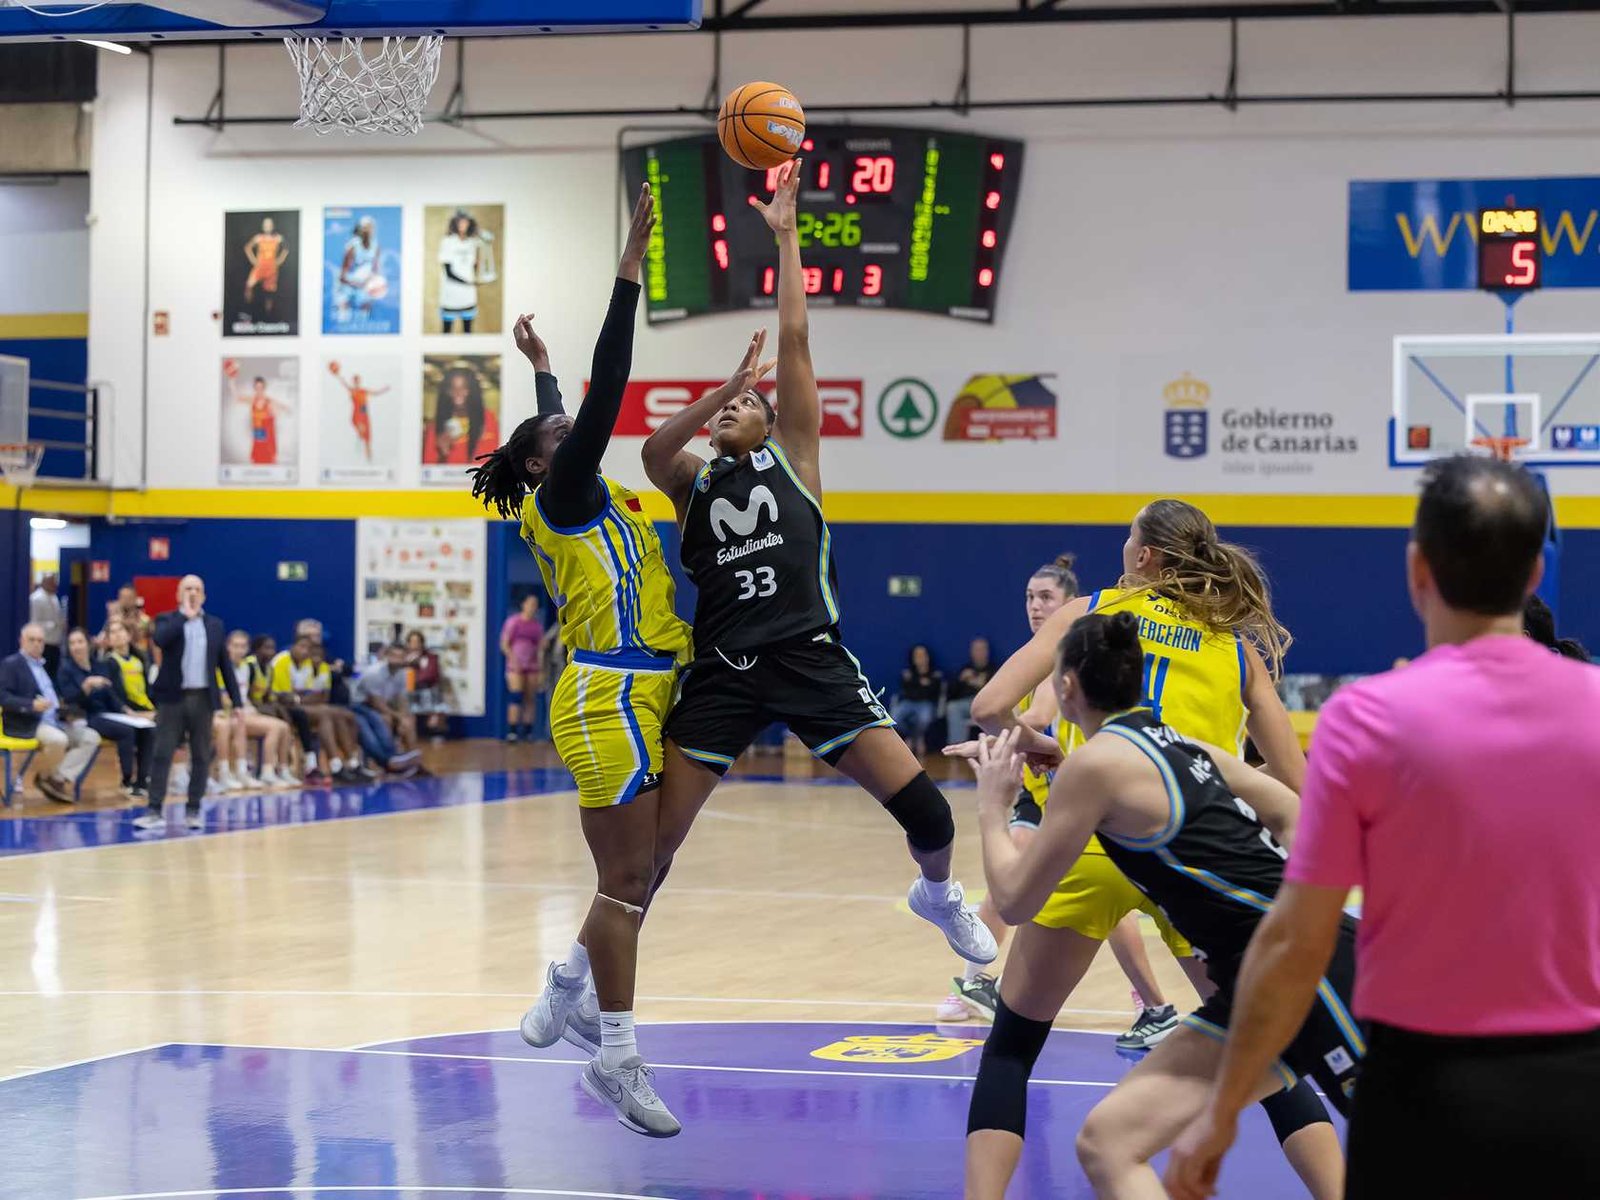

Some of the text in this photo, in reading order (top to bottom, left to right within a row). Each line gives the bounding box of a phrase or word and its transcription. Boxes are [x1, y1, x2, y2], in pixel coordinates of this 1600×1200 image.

[853, 157, 895, 193] 20
[863, 264, 882, 296] 3
[1222, 409, 1333, 429] Gobierno
[1221, 432, 1358, 454] de Canarias
[716, 531, 784, 566] Estudiantes
[734, 565, 778, 600] 33
[1136, 616, 1202, 652] ERCERON
